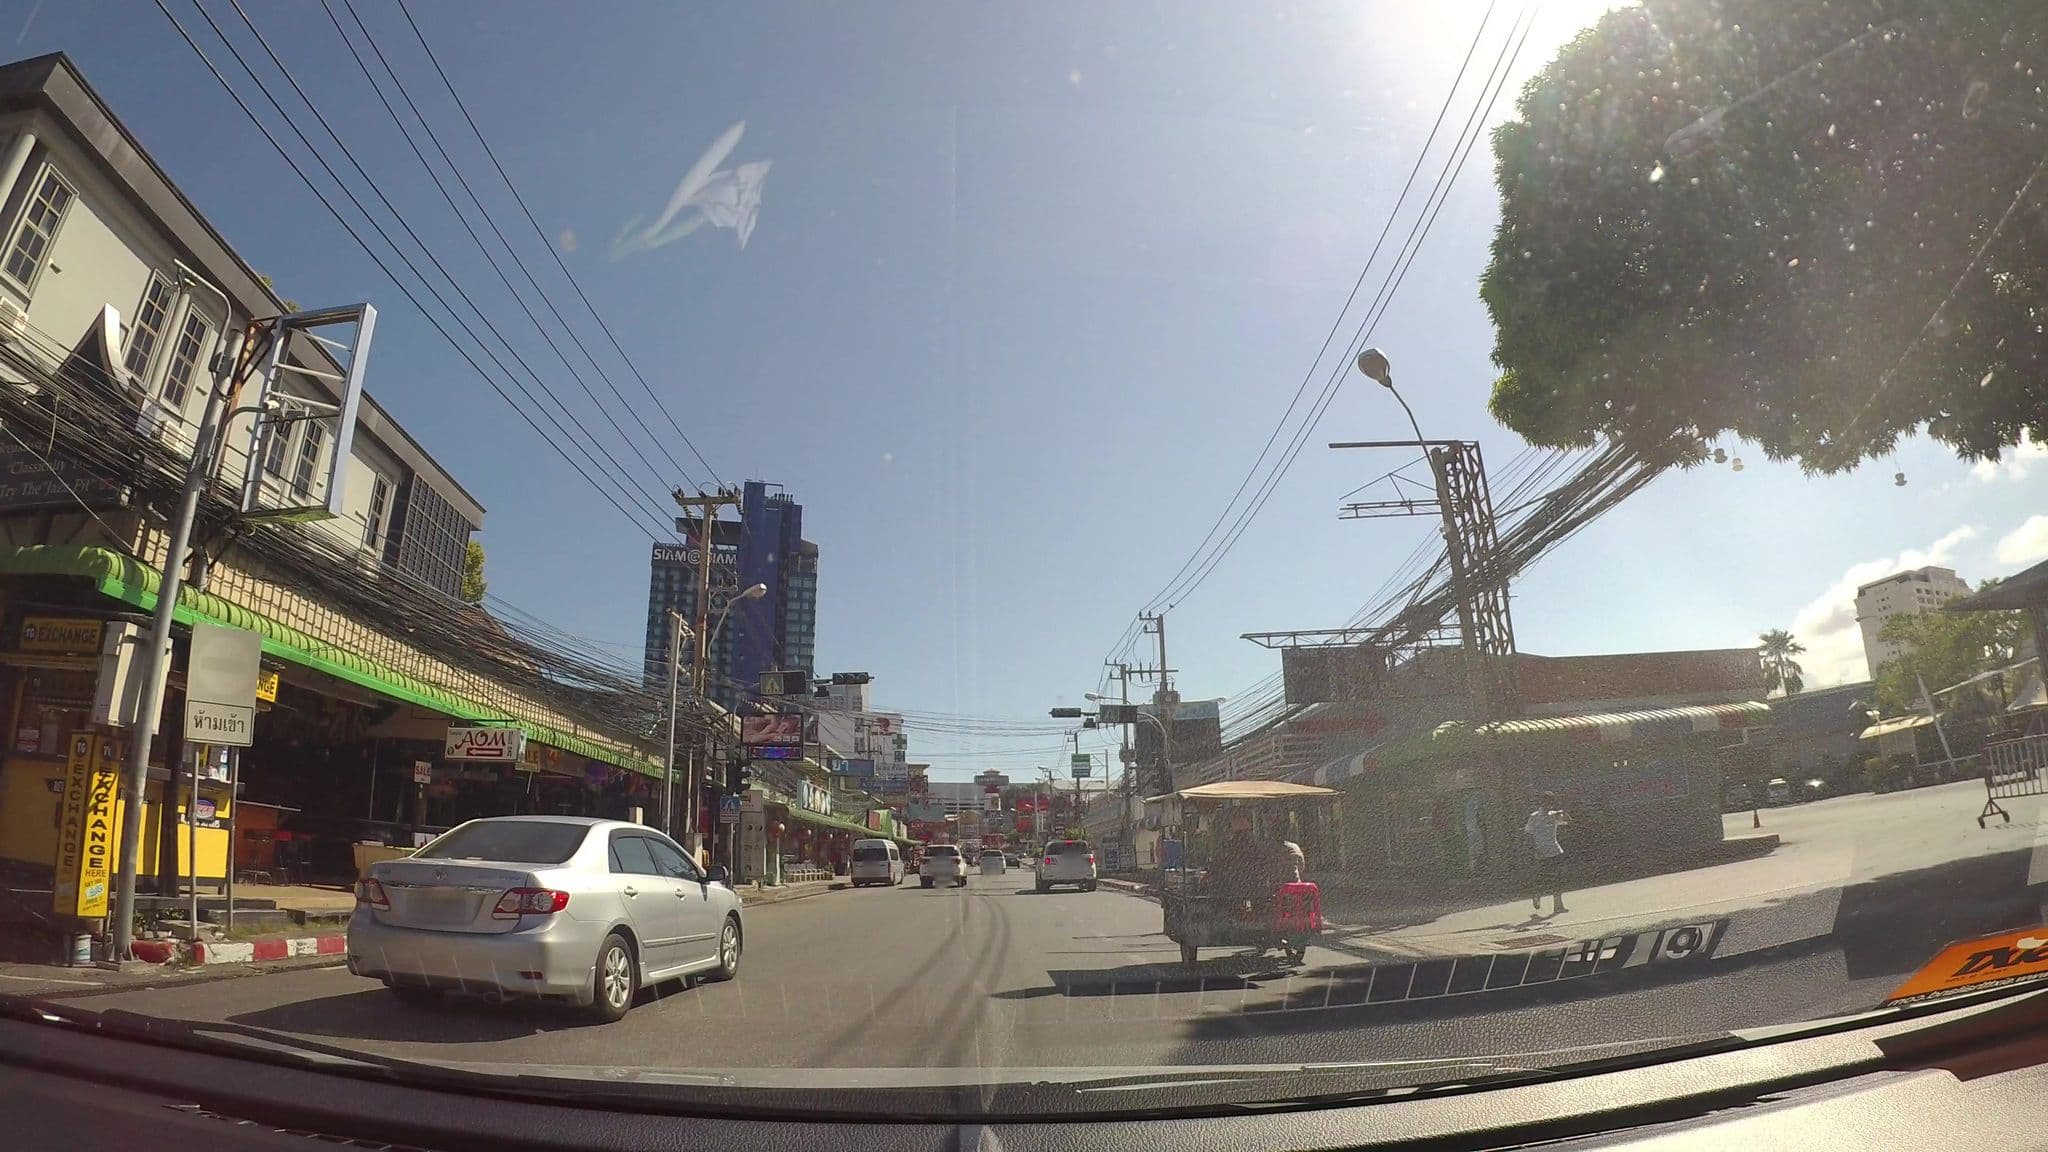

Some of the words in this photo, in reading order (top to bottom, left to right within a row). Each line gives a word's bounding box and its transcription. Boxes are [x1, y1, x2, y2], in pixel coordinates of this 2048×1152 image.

[39, 626, 98, 645] EXCHANGE
[194, 707, 245, 734] ห้ามเข้า
[455, 729, 506, 749] AOM
[416, 765, 432, 777] SALE
[62, 763, 85, 867] EXCHANGE
[88, 766, 111, 869] EXCHANGE
[85, 869, 107, 878] HERE
